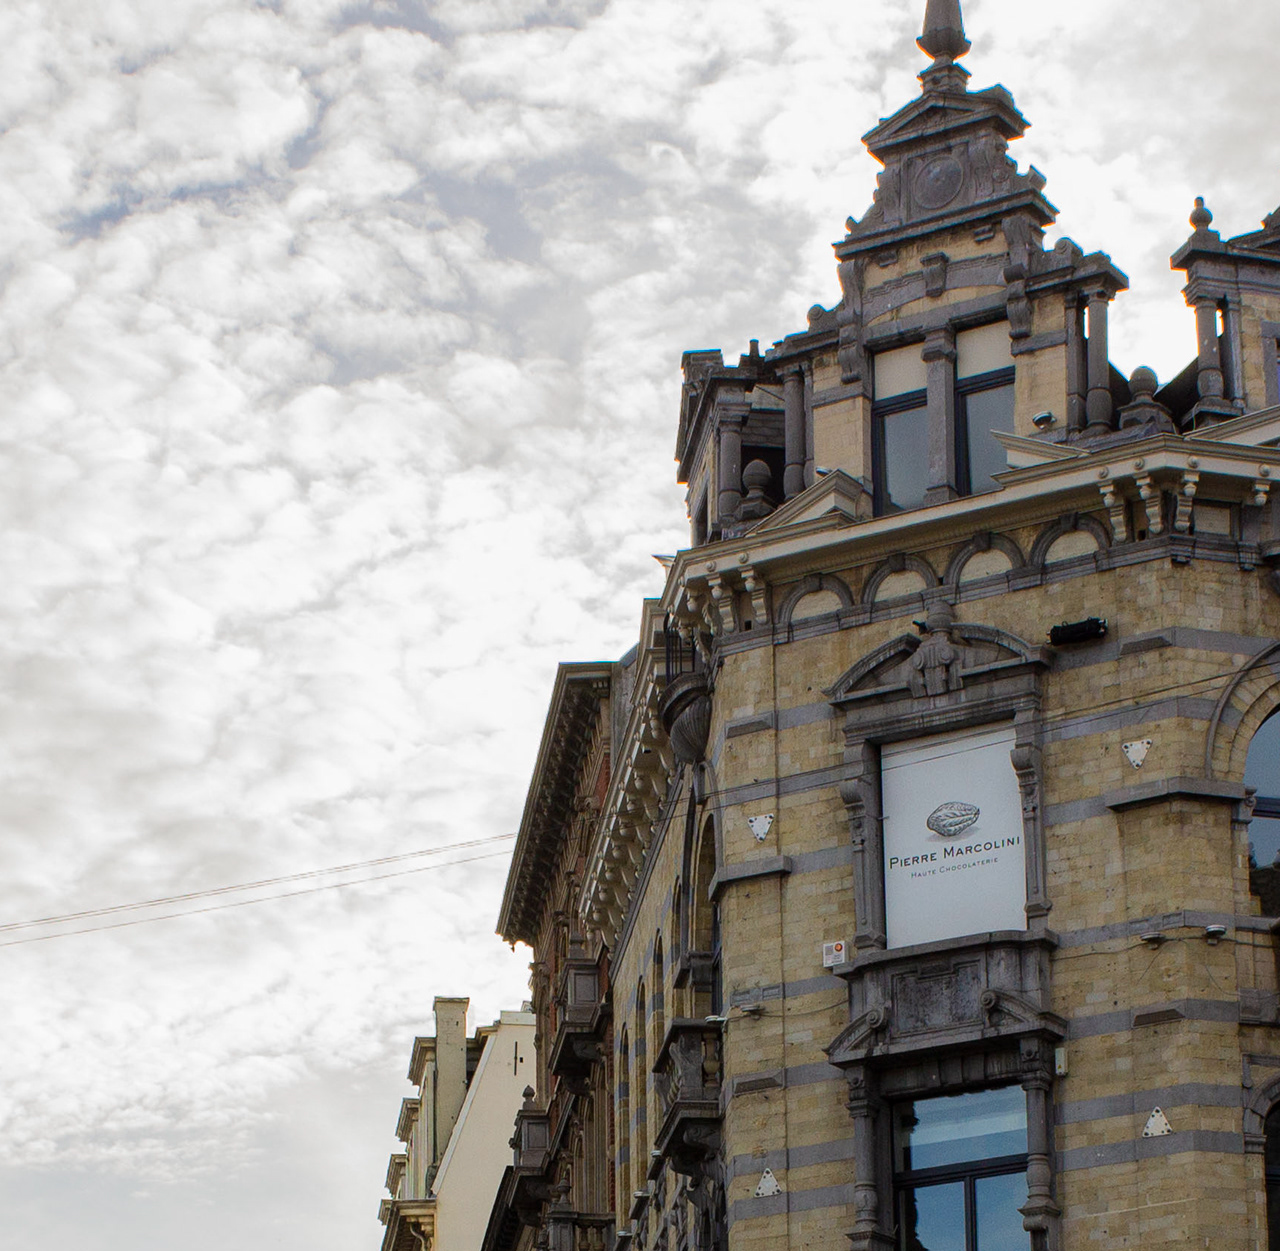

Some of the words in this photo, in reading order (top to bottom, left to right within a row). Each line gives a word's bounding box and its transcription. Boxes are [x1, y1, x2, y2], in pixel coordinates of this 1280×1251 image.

[889, 851, 937, 869] PIERRE
[943, 836, 1020, 859] MARCOLINI
[910, 868, 937, 879] HAUTE
[939, 857, 999, 874] CHOCOLATERIE
